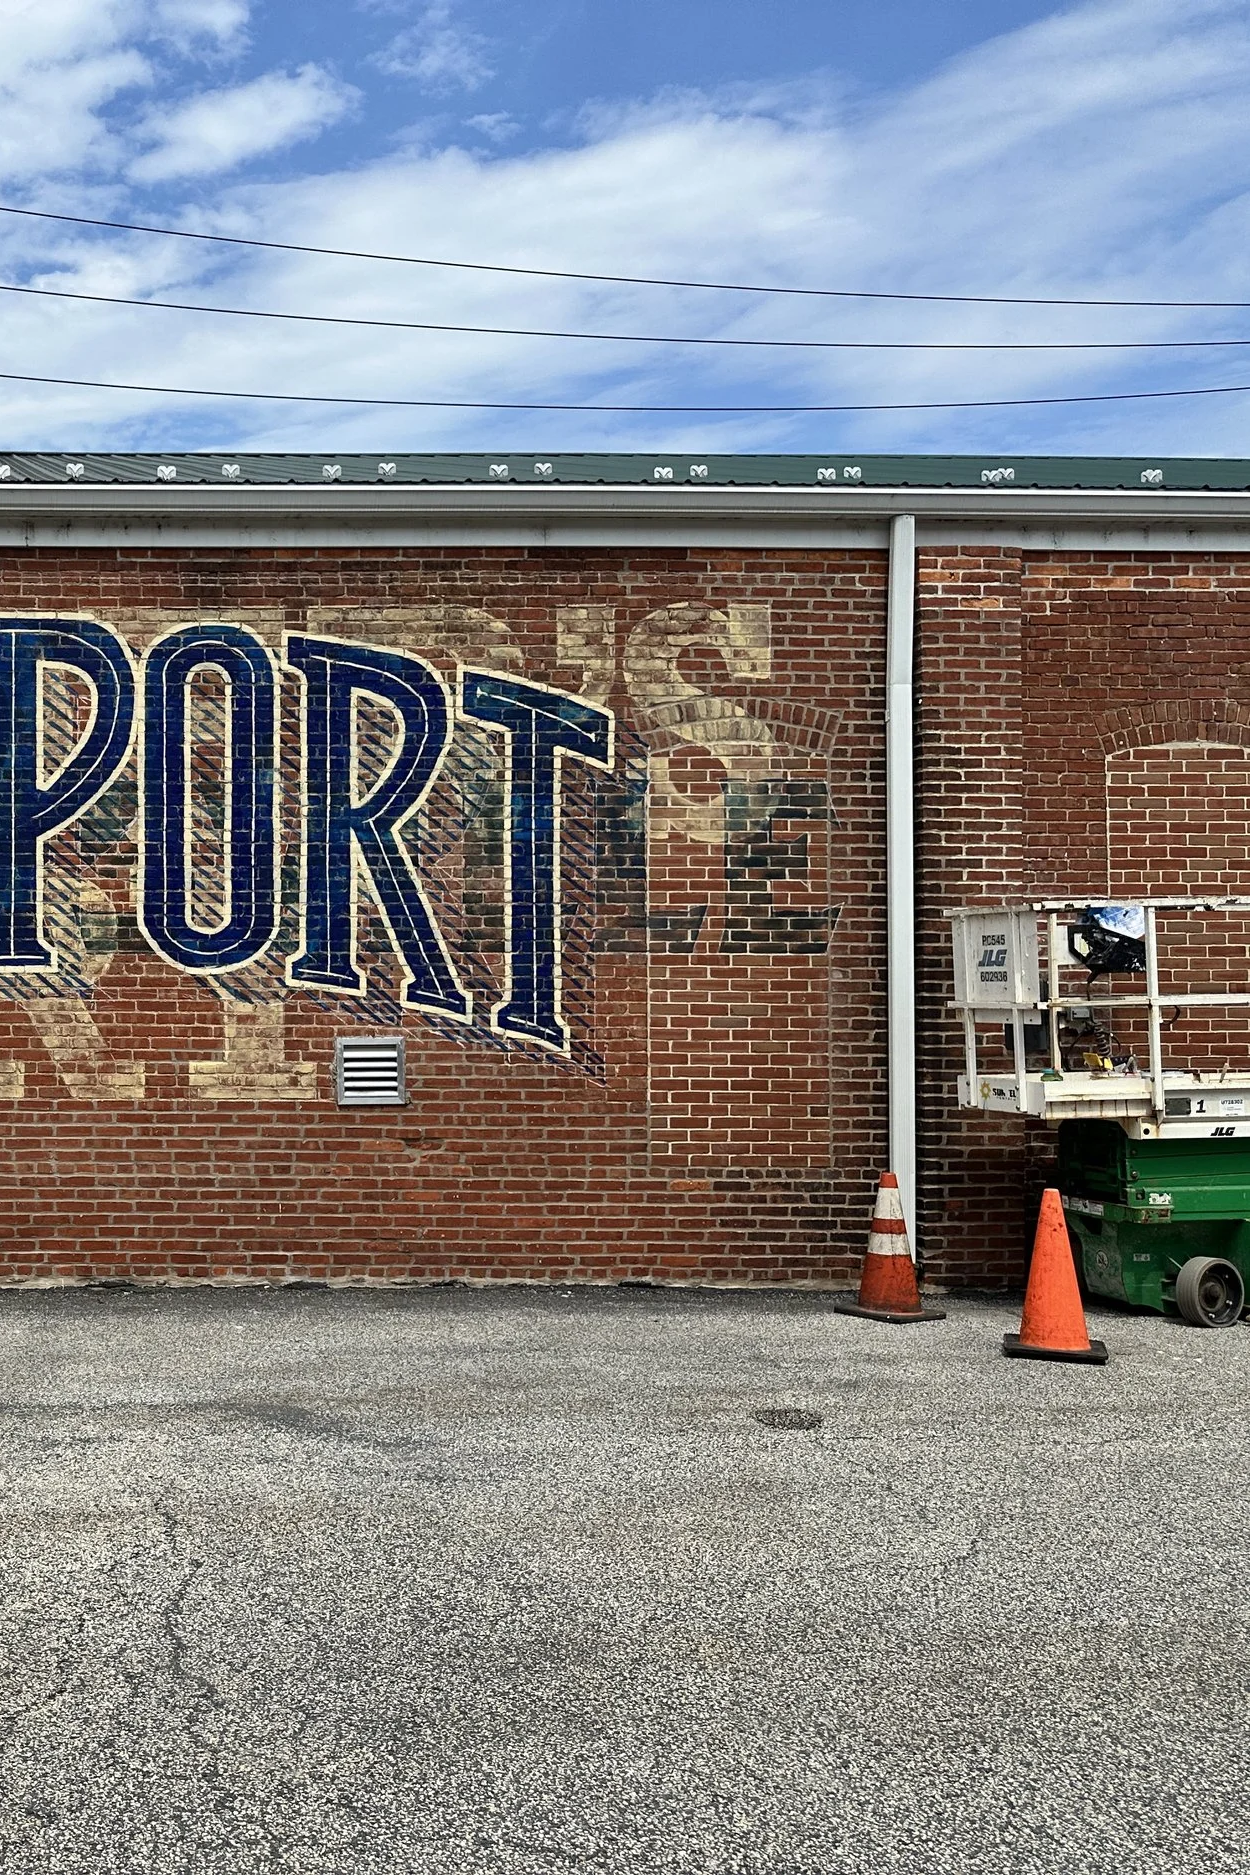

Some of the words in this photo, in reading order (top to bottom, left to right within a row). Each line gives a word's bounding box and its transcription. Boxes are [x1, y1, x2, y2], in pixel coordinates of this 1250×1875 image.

[977, 949, 1008, 967] JLG
[1195, 1099, 1206, 1114] 1
[1210, 1126, 1236, 1137] JLG
